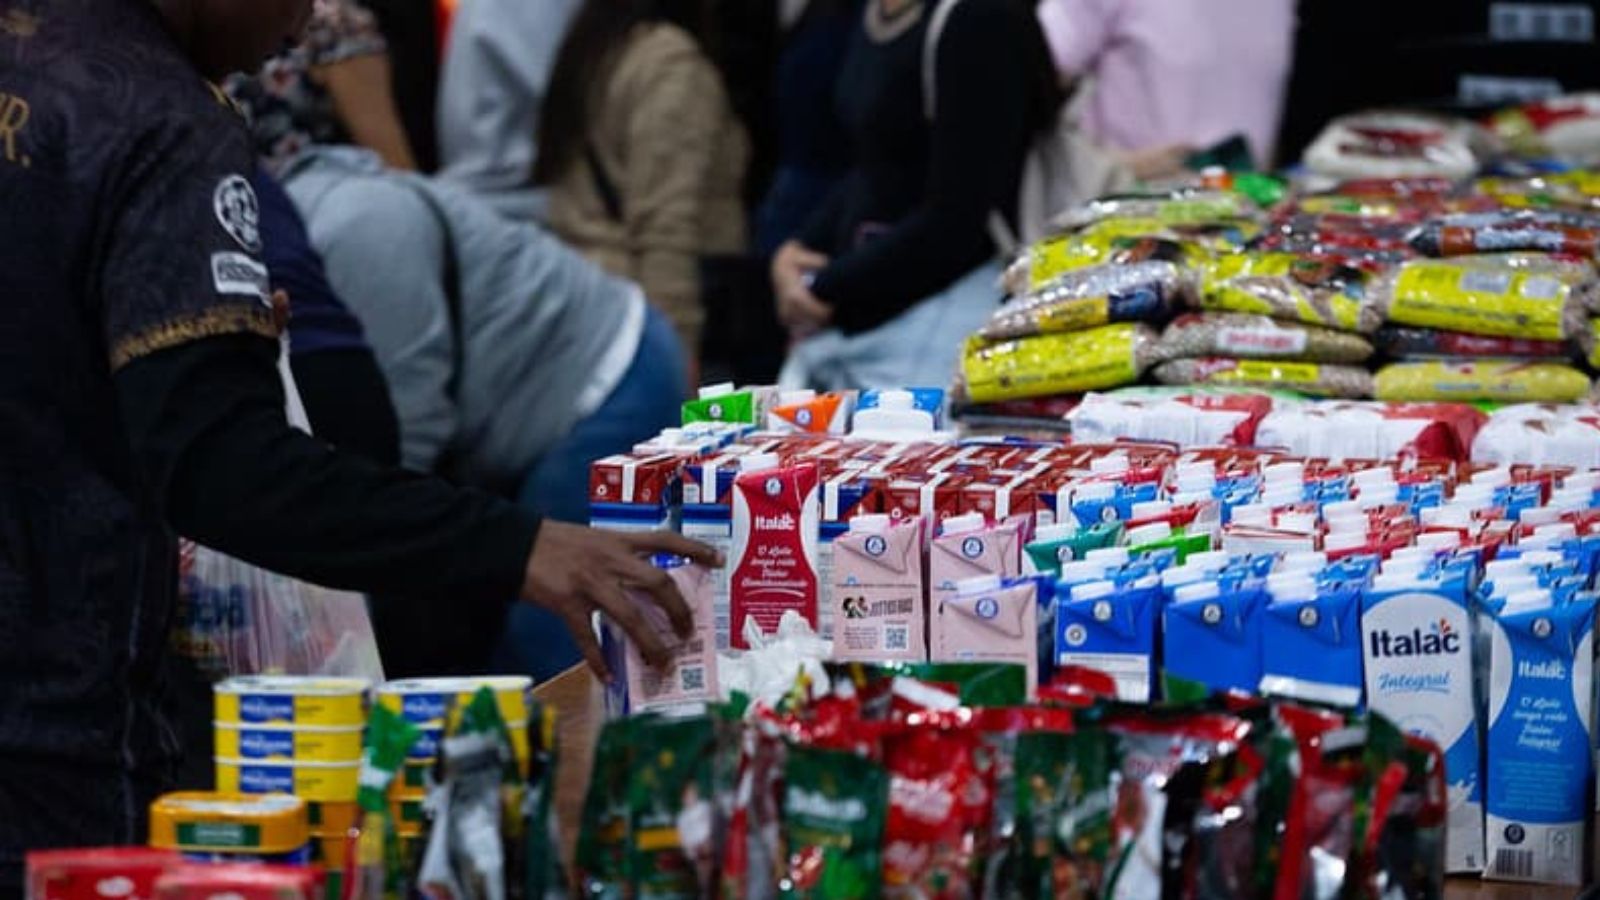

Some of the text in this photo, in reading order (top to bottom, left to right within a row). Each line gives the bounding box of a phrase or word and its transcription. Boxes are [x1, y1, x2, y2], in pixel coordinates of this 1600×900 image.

[755, 514, 796, 532] Italac
[1370, 626, 1460, 658] Italac
[1518, 660, 1566, 680] Italac
[1379, 671, 1451, 692] Integral
